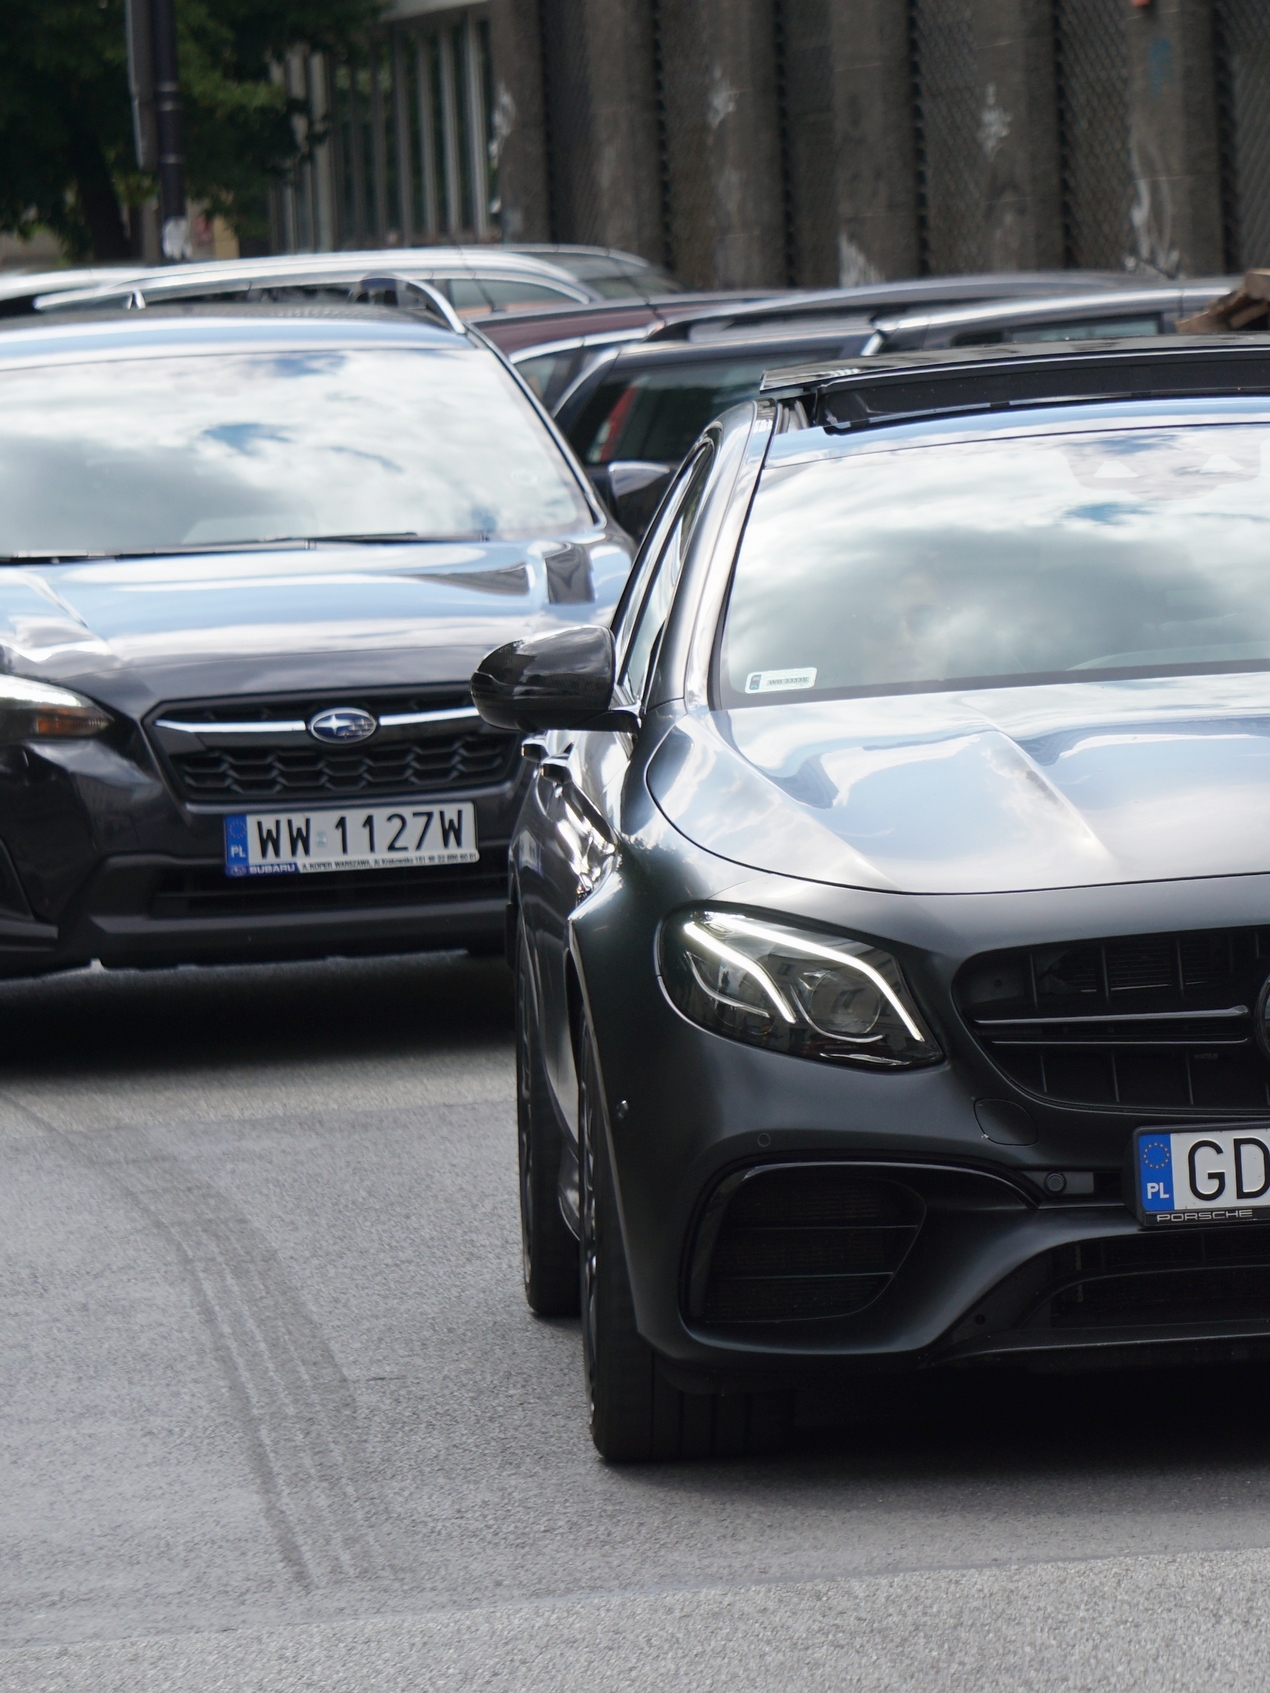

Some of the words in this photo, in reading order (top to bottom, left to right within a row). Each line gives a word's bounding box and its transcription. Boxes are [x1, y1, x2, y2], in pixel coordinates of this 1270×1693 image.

[257, 818, 311, 859] WW
[335, 809, 463, 855] 1127W
[231, 845, 246, 858] PL
[249, 864, 296, 874] SUBARU
[1146, 1182, 1170, 1199] PL
[1156, 1209, 1253, 1222] PORSCHE
